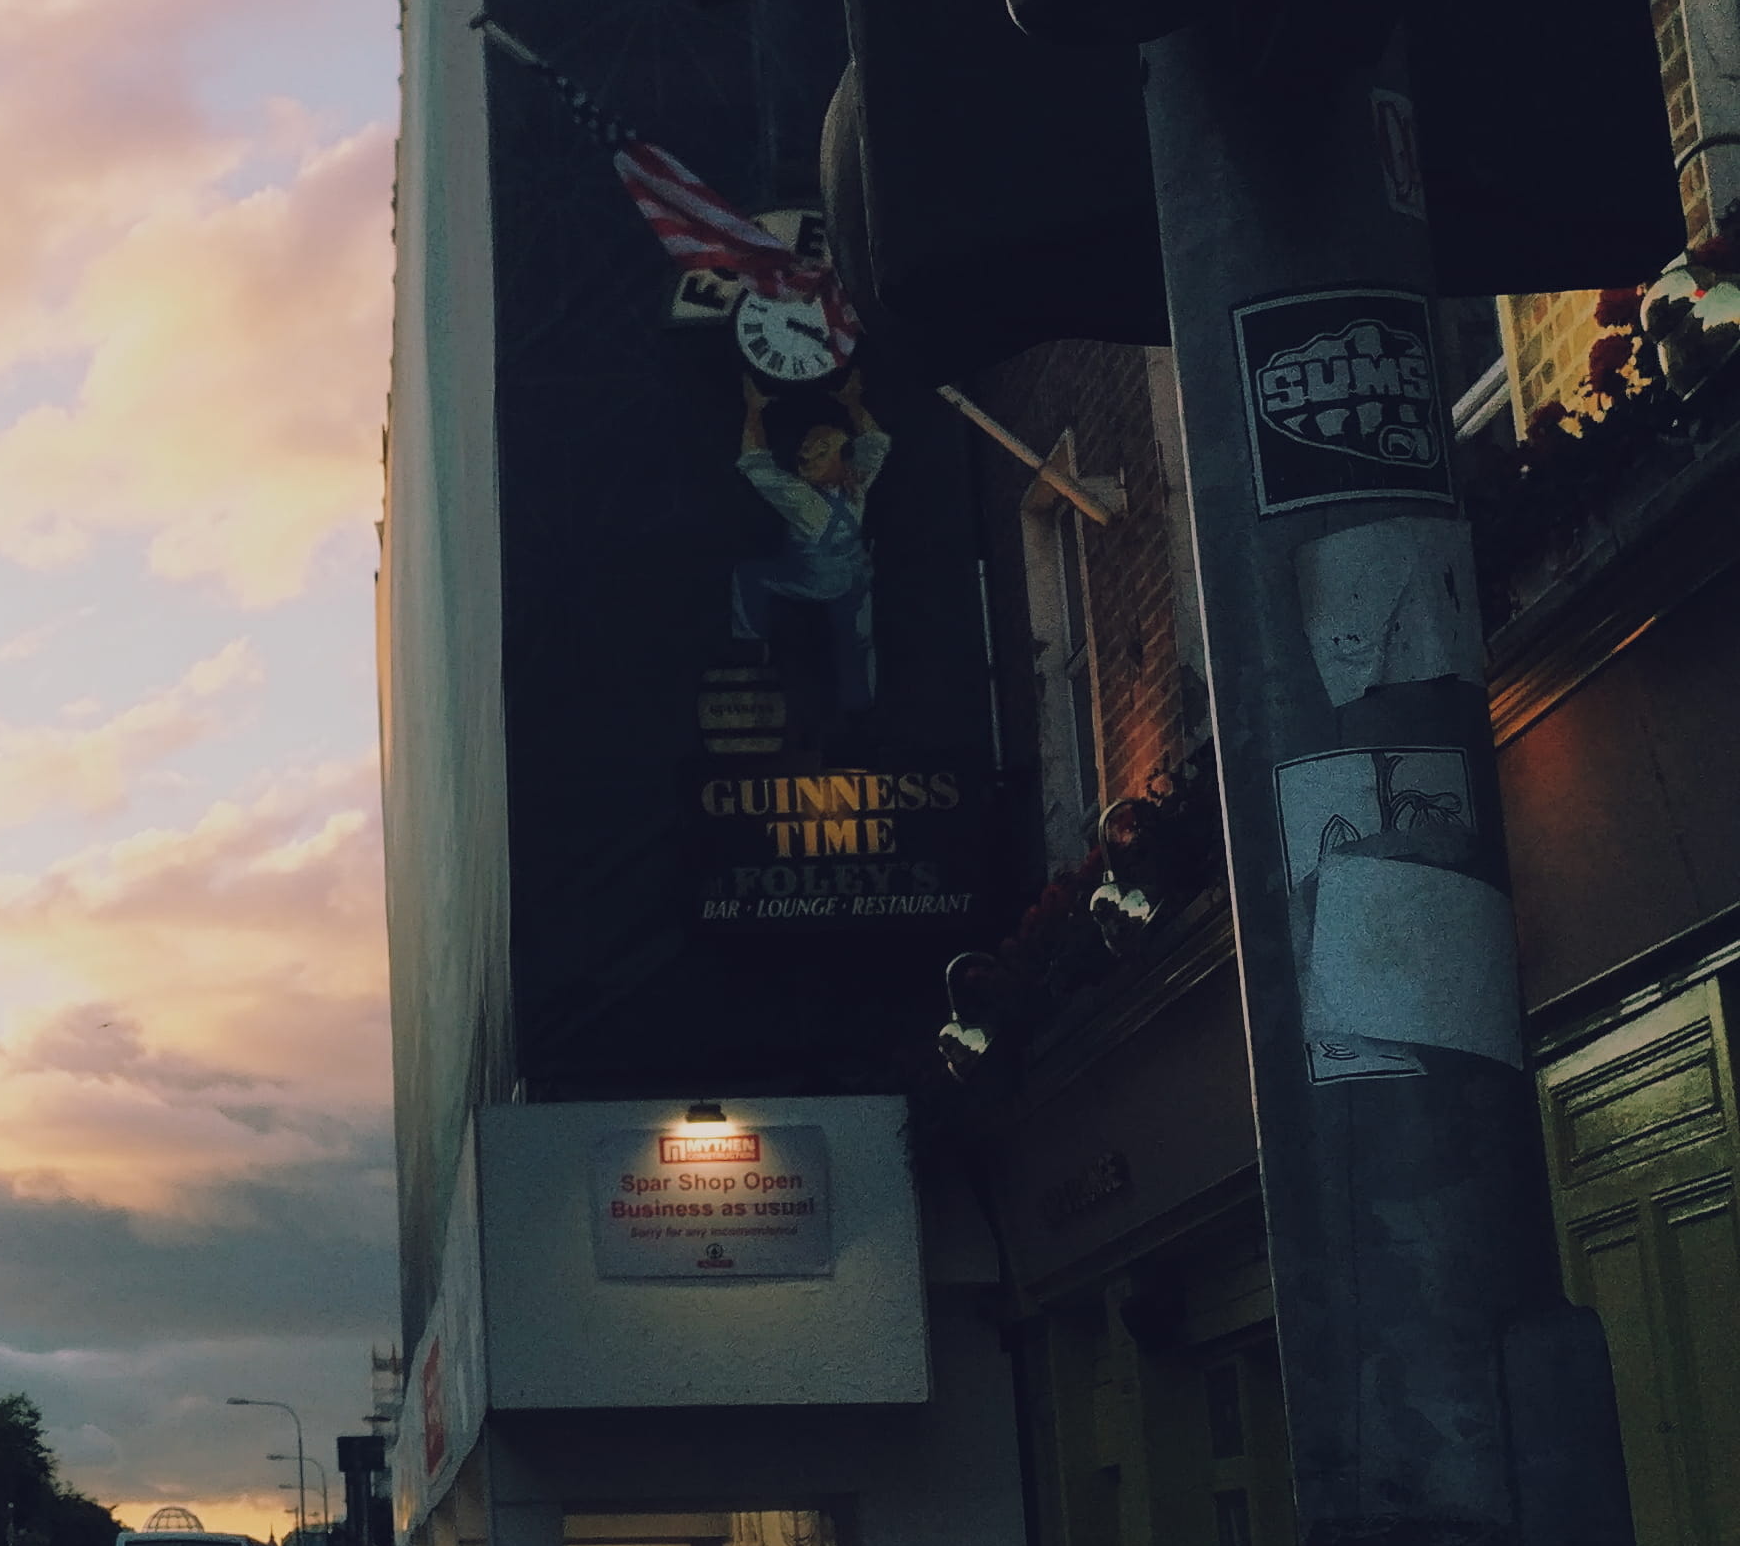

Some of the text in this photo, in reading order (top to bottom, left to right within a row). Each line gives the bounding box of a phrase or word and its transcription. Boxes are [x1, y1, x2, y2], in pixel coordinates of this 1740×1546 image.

[701, 772, 960, 817] GUINNESS
[765, 817, 897, 858] TIME
[701, 893, 973, 919] BAR LOUNGE RESTAURANT
[686, 1138, 755, 1152] MYTHEN
[621, 1171, 803, 1195] Spar Shop Open
[611, 1197, 815, 1219] Business as usual
[630, 1227, 662, 1240] Sorry
[665, 1226, 682, 1237] for
[685, 1228, 707, 1240] any
